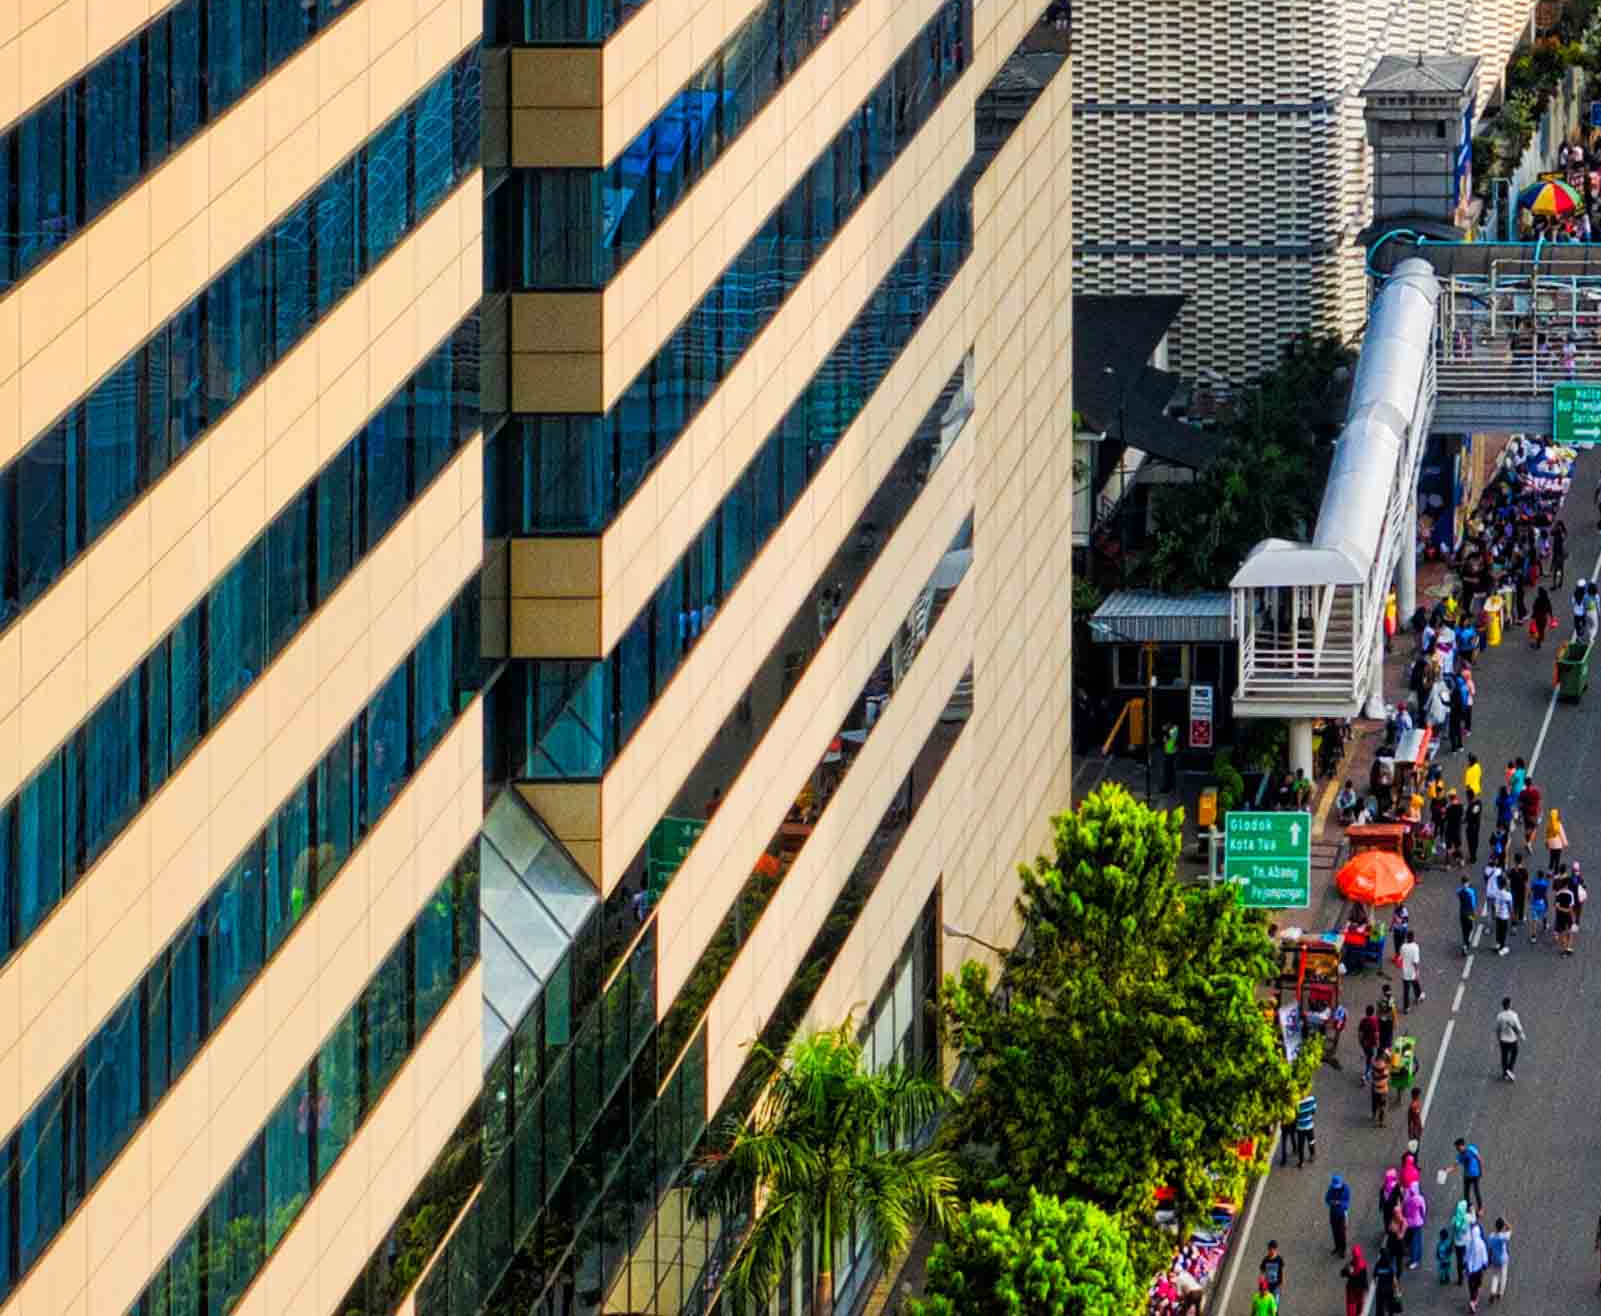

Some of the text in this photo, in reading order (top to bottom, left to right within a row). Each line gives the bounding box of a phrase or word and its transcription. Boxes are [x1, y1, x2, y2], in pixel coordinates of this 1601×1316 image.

[1230, 818, 1272, 831] Glodok
[1230, 838, 1276, 851] Kota Tua
